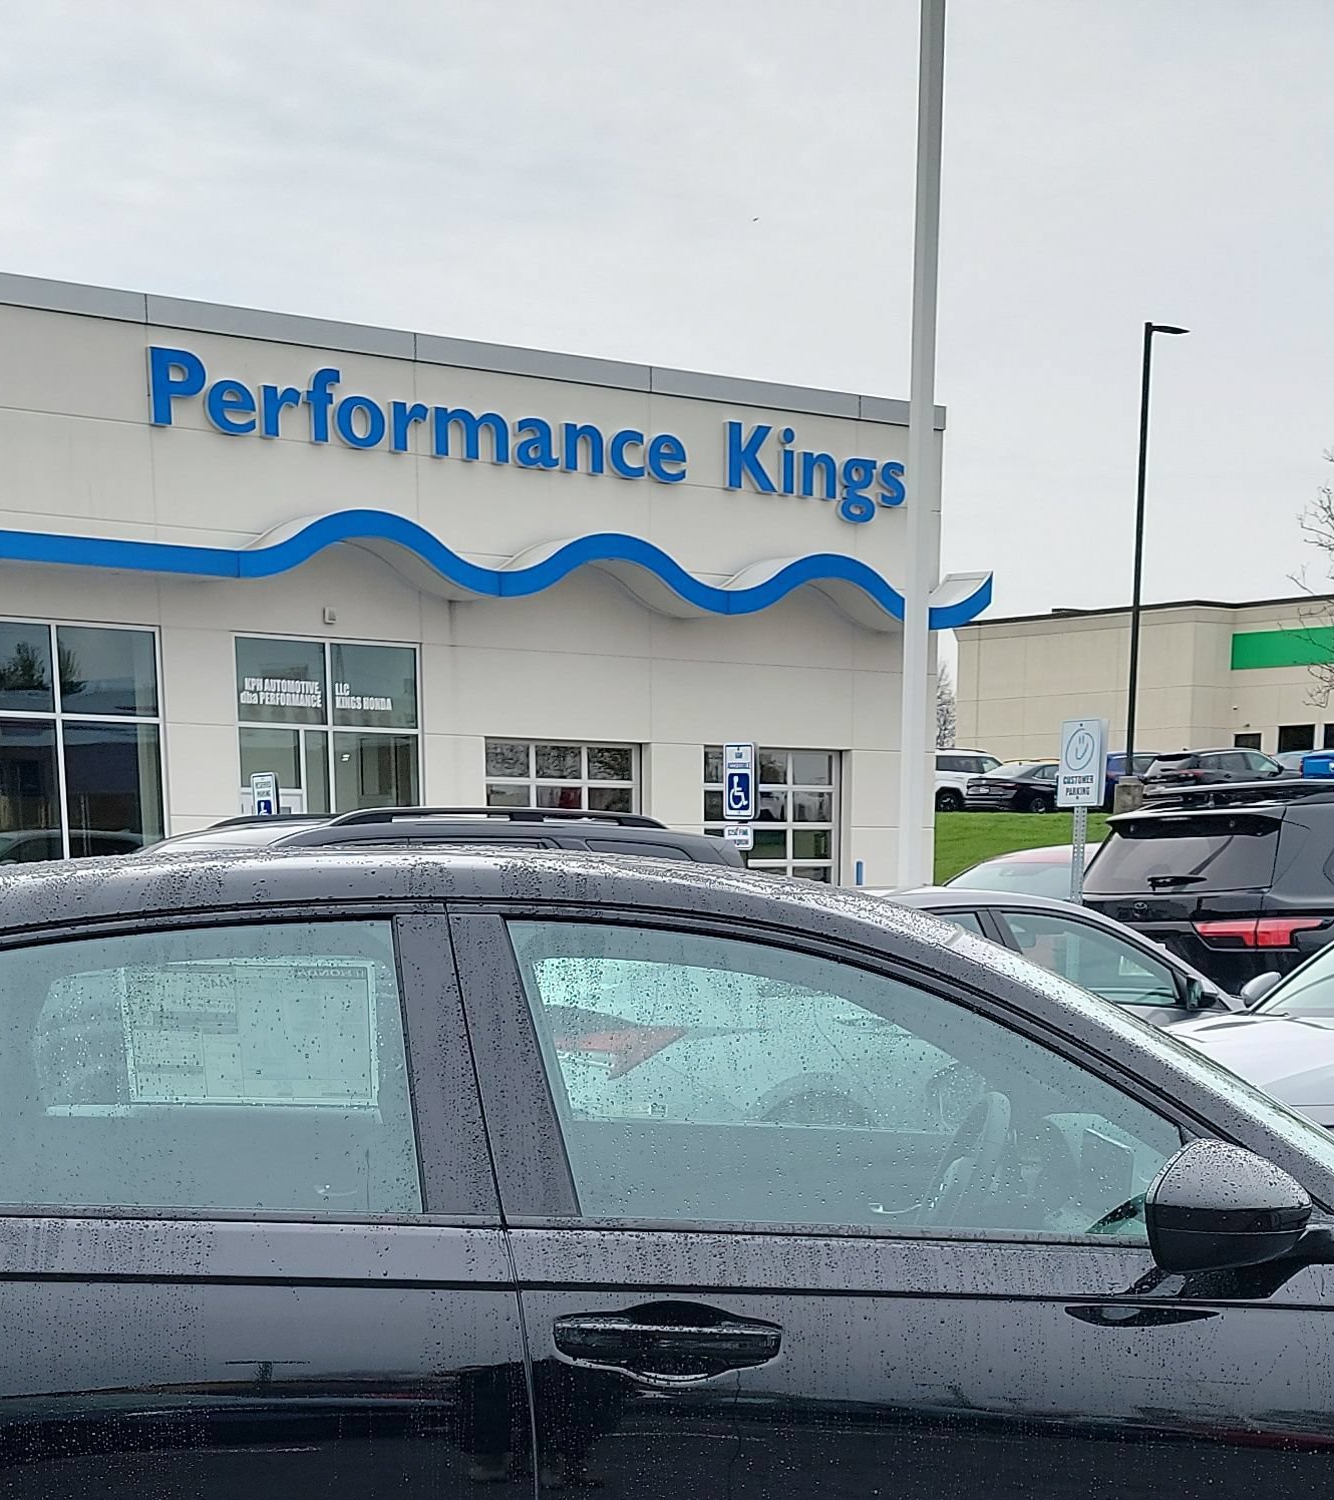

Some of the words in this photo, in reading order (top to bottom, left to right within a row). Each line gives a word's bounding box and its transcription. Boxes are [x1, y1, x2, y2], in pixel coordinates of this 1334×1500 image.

[146, 345, 688, 483] Performance
[723, 419, 907, 524] Kings
[244, 677, 263, 691] KPH
[335, 682, 351, 696] LLC
[259, 691, 322, 708] PERFORMANCE
[335, 696, 362, 710] KINGS
[362, 697, 393, 711] HONDA
[1063, 775, 1094, 785] CUSTOMER
[1065, 787, 1090, 796] PARKING
